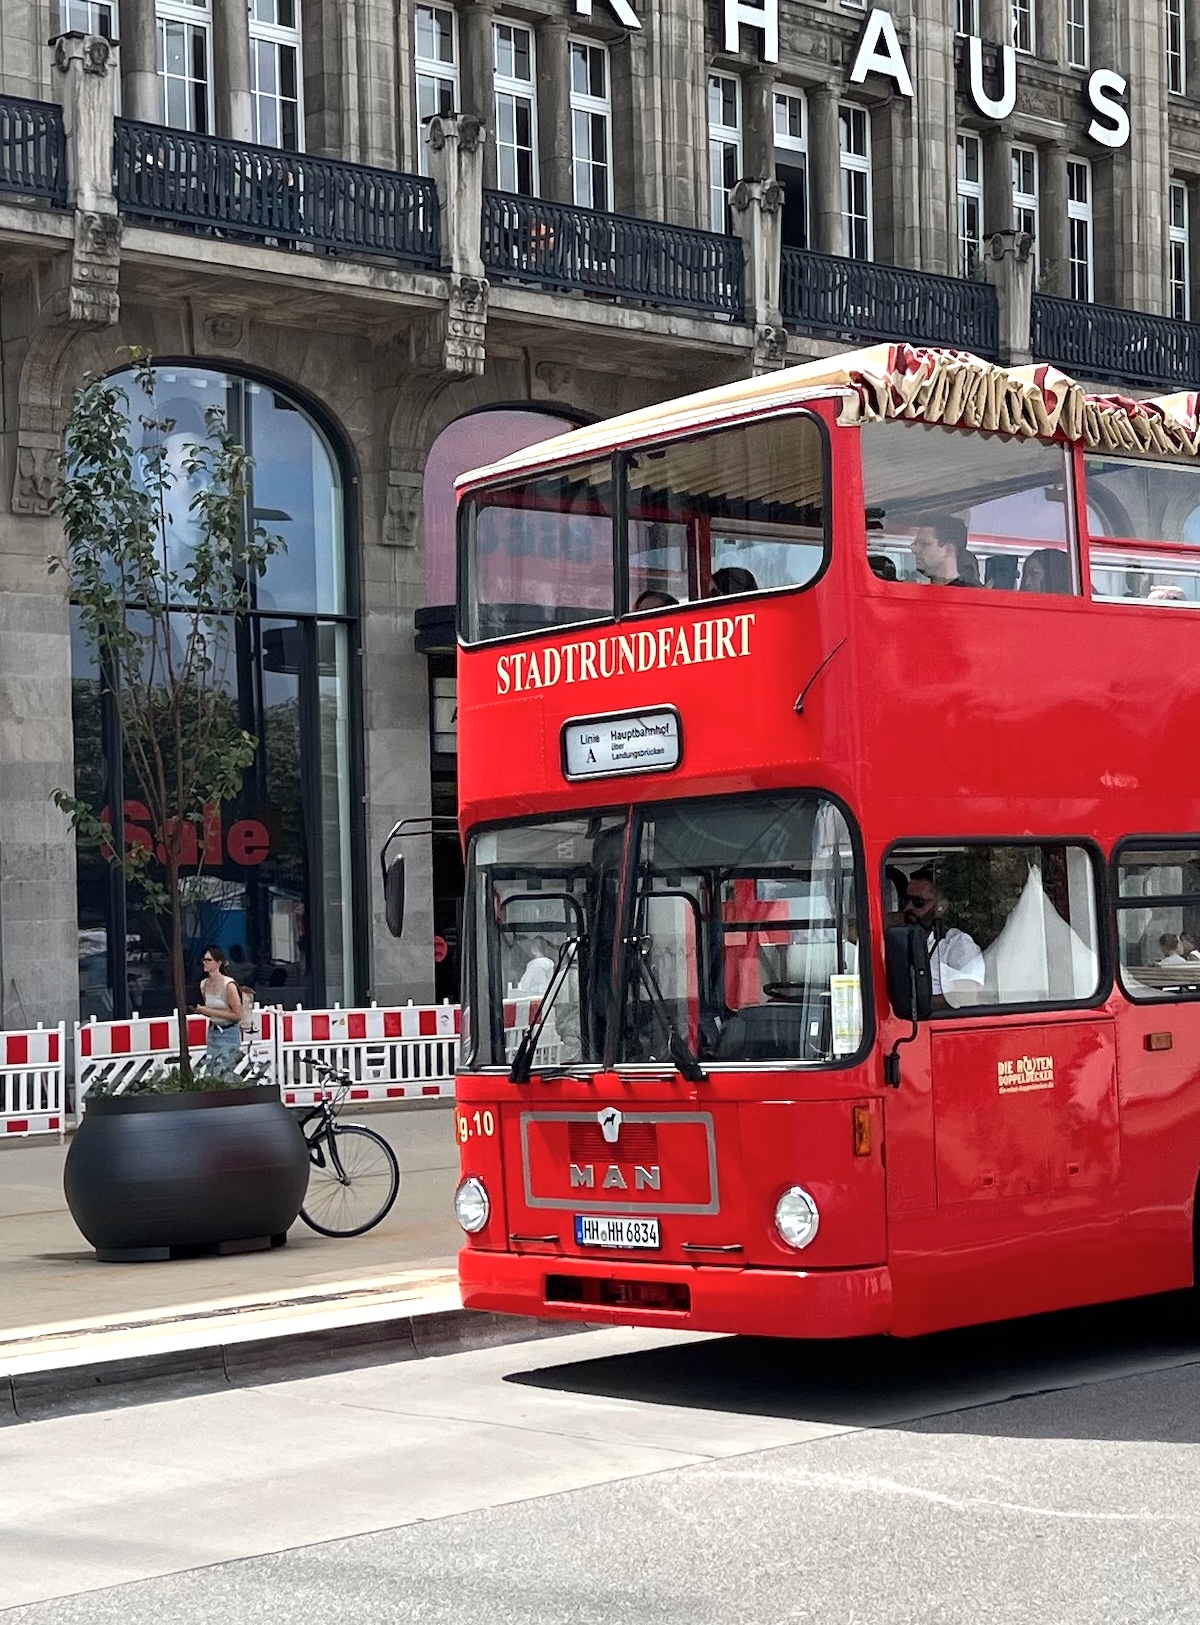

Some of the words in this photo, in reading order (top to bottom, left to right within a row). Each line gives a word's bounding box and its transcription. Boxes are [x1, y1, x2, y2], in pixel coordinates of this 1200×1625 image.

[496, 614, 756, 695] STADTRUNDFAHRT
[580, 734, 600, 745] Linie
[610, 723, 670, 741] Hauptbahnhof
[586, 748, 597, 763] A
[100, 800, 270, 866] Sale
[998, 1061, 1014, 1075] DIE
[570, 1163, 661, 1190] MAN
[627, 1222, 657, 1243] 6834
